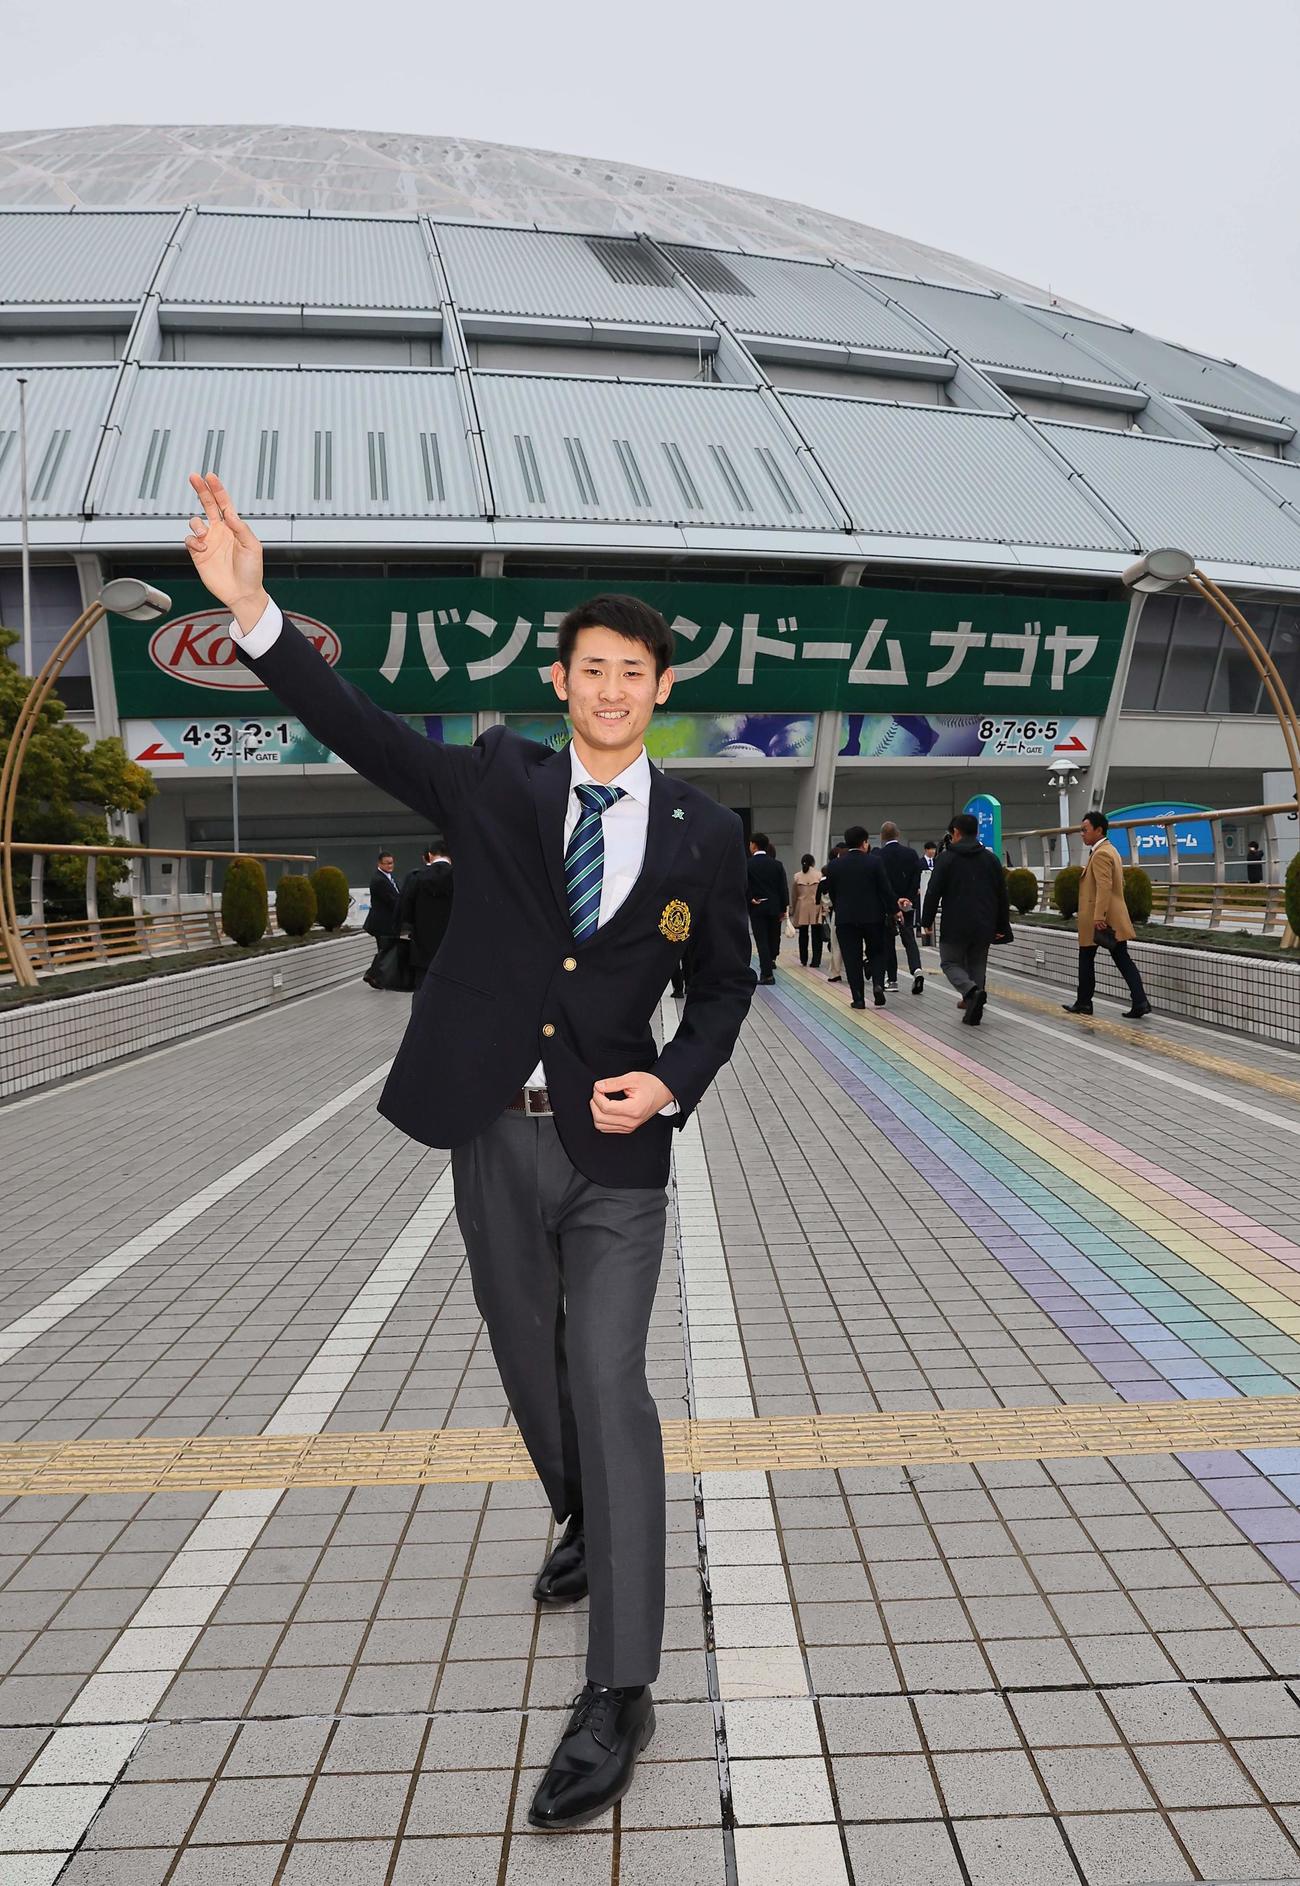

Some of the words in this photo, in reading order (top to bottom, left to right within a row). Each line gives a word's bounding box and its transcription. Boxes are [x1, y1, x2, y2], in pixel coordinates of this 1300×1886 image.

[168, 623, 331, 667] Ko
[379, 607, 909, 686] バンンドーム
[926, 620, 1100, 691] ナゴヤ
[211, 747, 254, 762] ゲート
[255, 753, 279, 761] GATE
[995, 741, 1026, 753] ゲート
[1026, 746, 1043, 754] GATE
